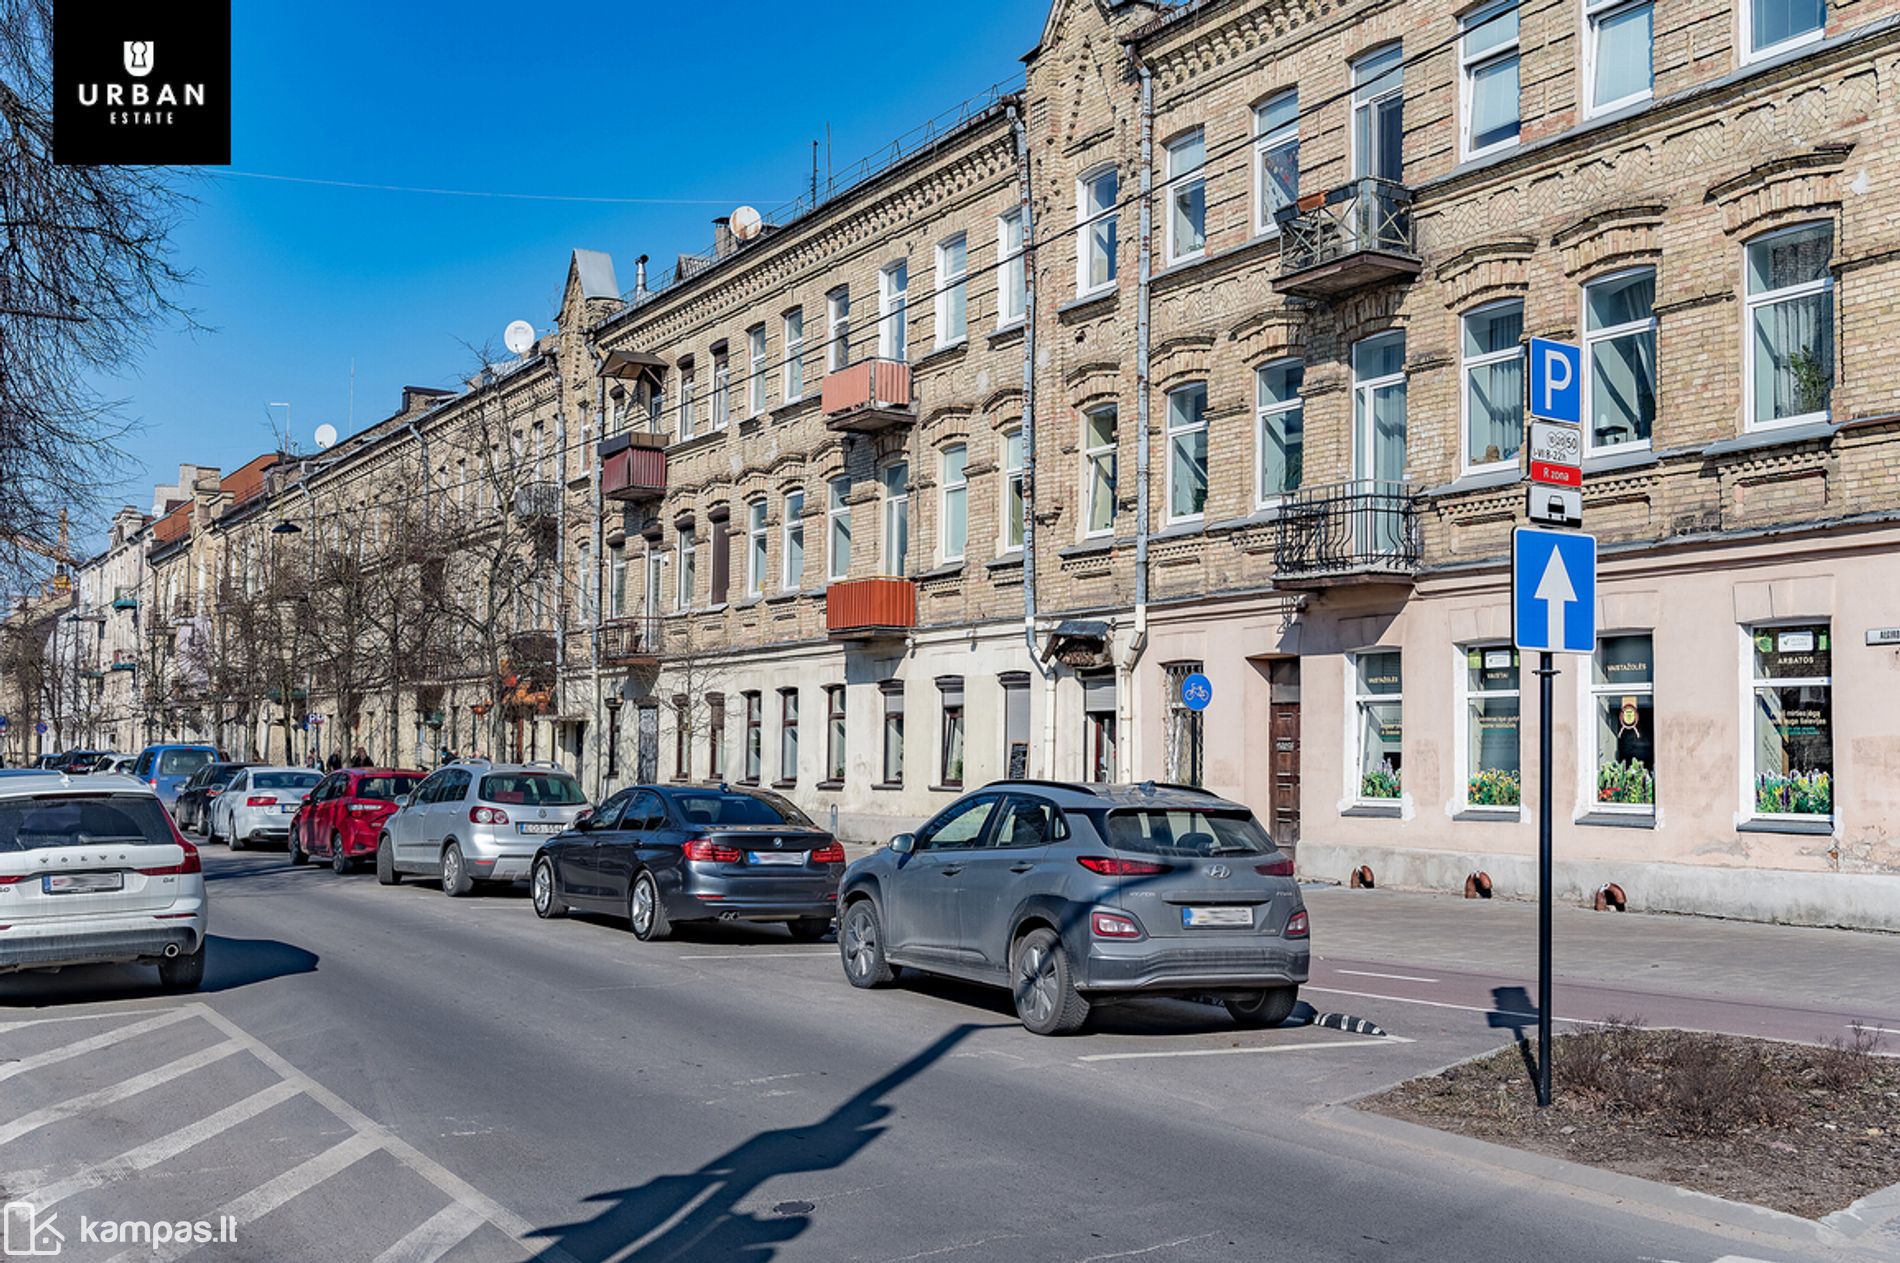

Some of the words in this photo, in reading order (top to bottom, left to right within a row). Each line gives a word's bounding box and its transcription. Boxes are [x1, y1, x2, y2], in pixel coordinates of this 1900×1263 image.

[1544, 349, 1573, 411] P
[1566, 437, 1577, 449] 50
[1543, 467, 1550, 478] R
[1551, 470, 1569, 481] zona
[1777, 656, 1814, 664] ARBATOS
[40, 854, 126, 863] VOLVO
